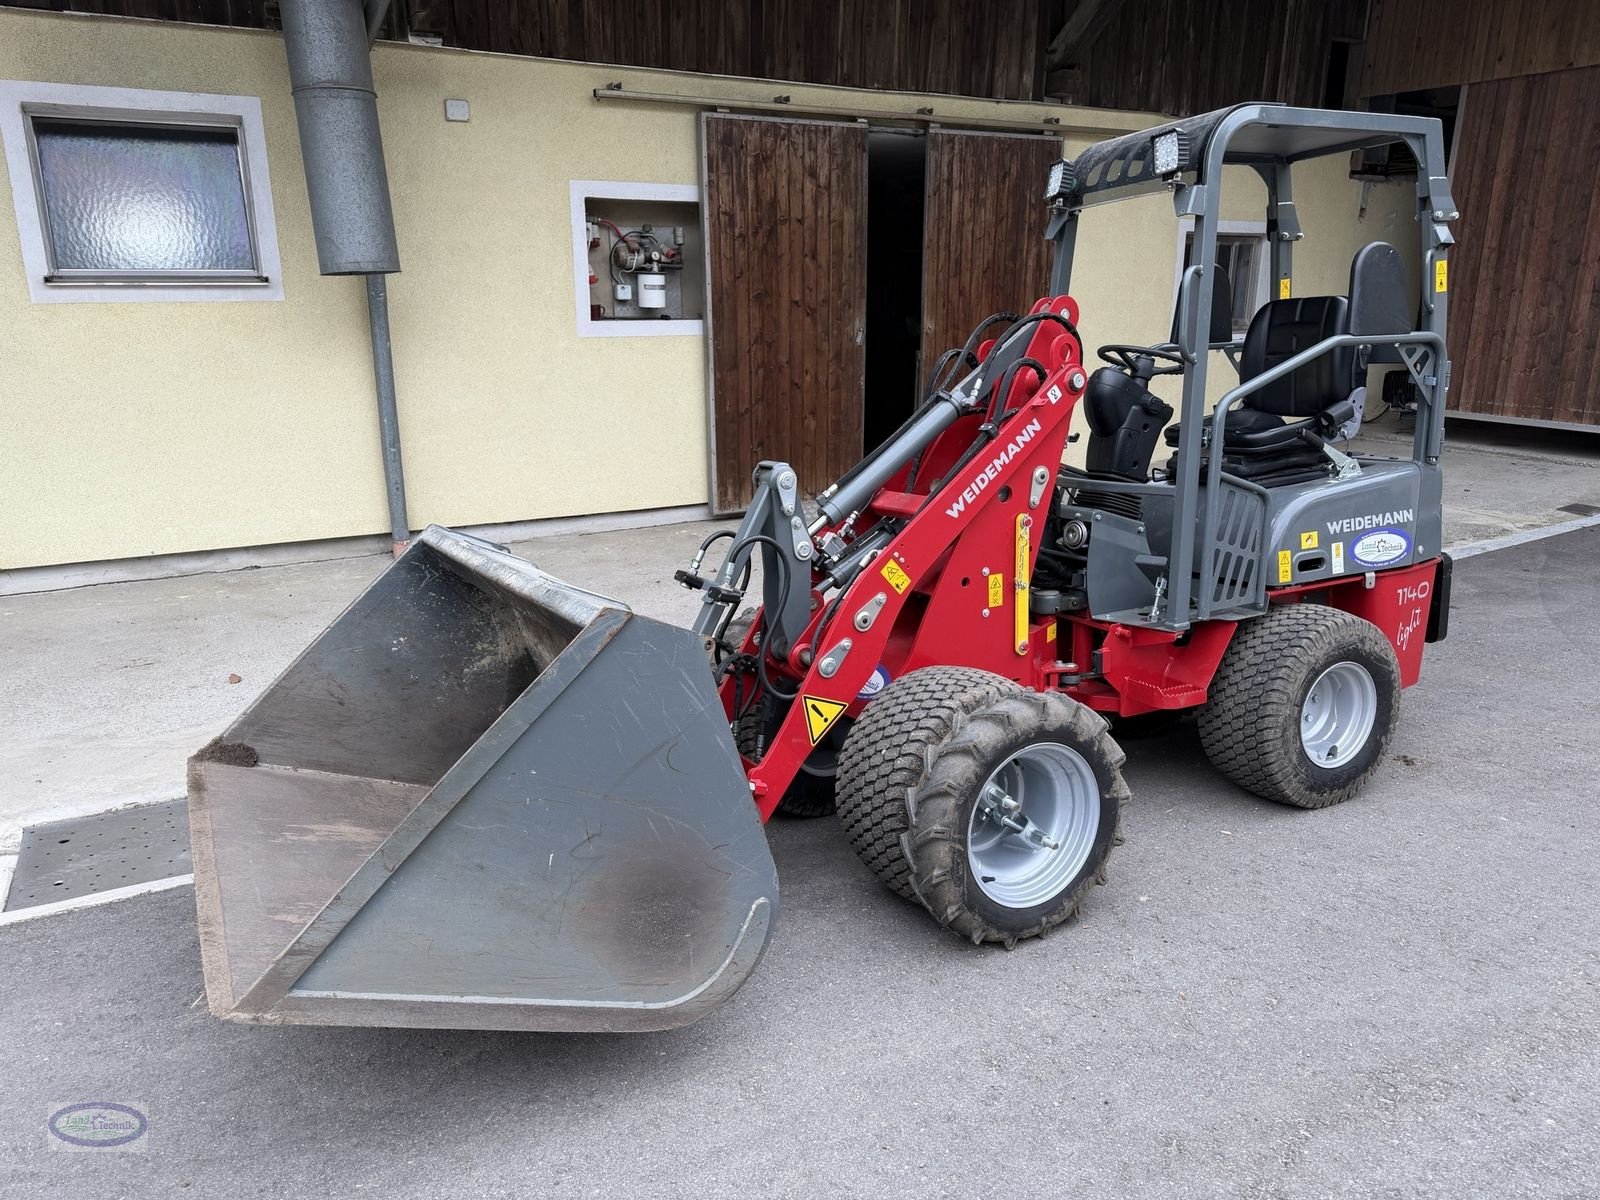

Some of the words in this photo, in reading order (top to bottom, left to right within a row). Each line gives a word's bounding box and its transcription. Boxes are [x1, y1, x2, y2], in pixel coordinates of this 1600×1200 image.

[945, 418, 1041, 518] WEIDEMANN
[1327, 509, 1413, 534] WEIDEMANN
[1361, 541, 1376, 550] Land
[1381, 543, 1403, 552] Technik
[1397, 581, 1429, 606] 1140
[1397, 606, 1422, 651] light
